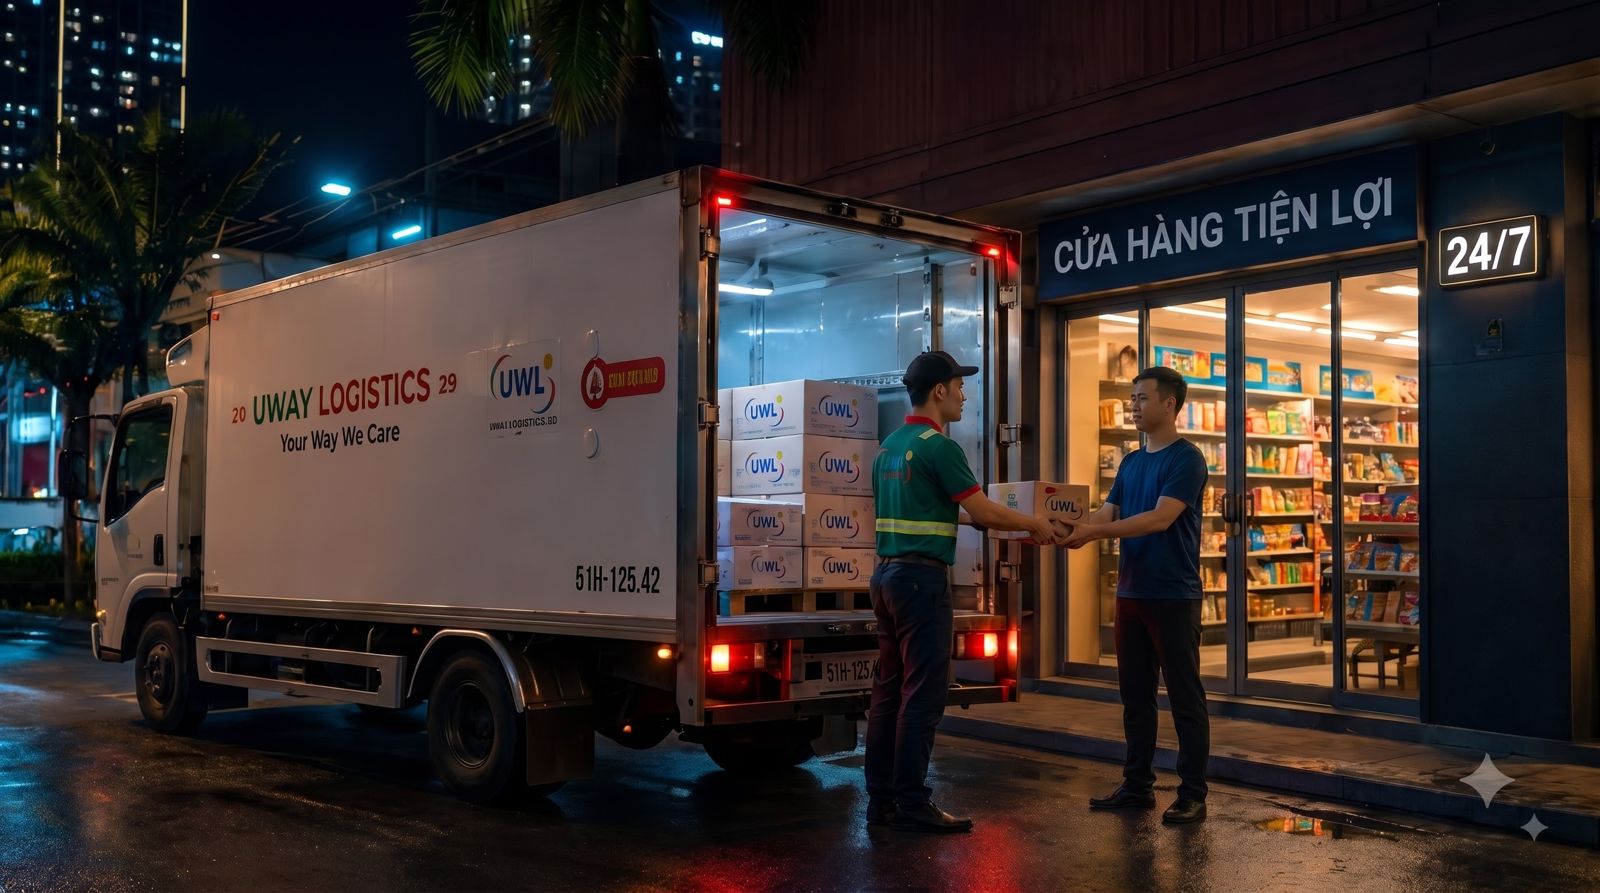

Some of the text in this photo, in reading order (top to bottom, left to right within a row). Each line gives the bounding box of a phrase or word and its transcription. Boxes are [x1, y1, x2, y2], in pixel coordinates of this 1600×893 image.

[1054, 177, 1392, 274] CỬA HÀNG TIỆN LỢI
[1447, 225, 1531, 276] 24/7
[500, 366, 545, 398] UWL
[232, 368, 457, 425] 20 UWAY LOGISTICS 29
[750, 403, 778, 420] UWL
[825, 402, 853, 418] UWL
[280, 423, 400, 453] Your Way We Care
[751, 458, 778, 474] UWL
[825, 458, 853, 474] UWL
[1050, 500, 1077, 513] UWL
[753, 516, 779, 528] UWL
[826, 515, 853, 529] UWL
[756, 562, 780, 573] UWL
[828, 562, 853, 574] UWL
[575, 565, 660, 594] 51H-125.42
